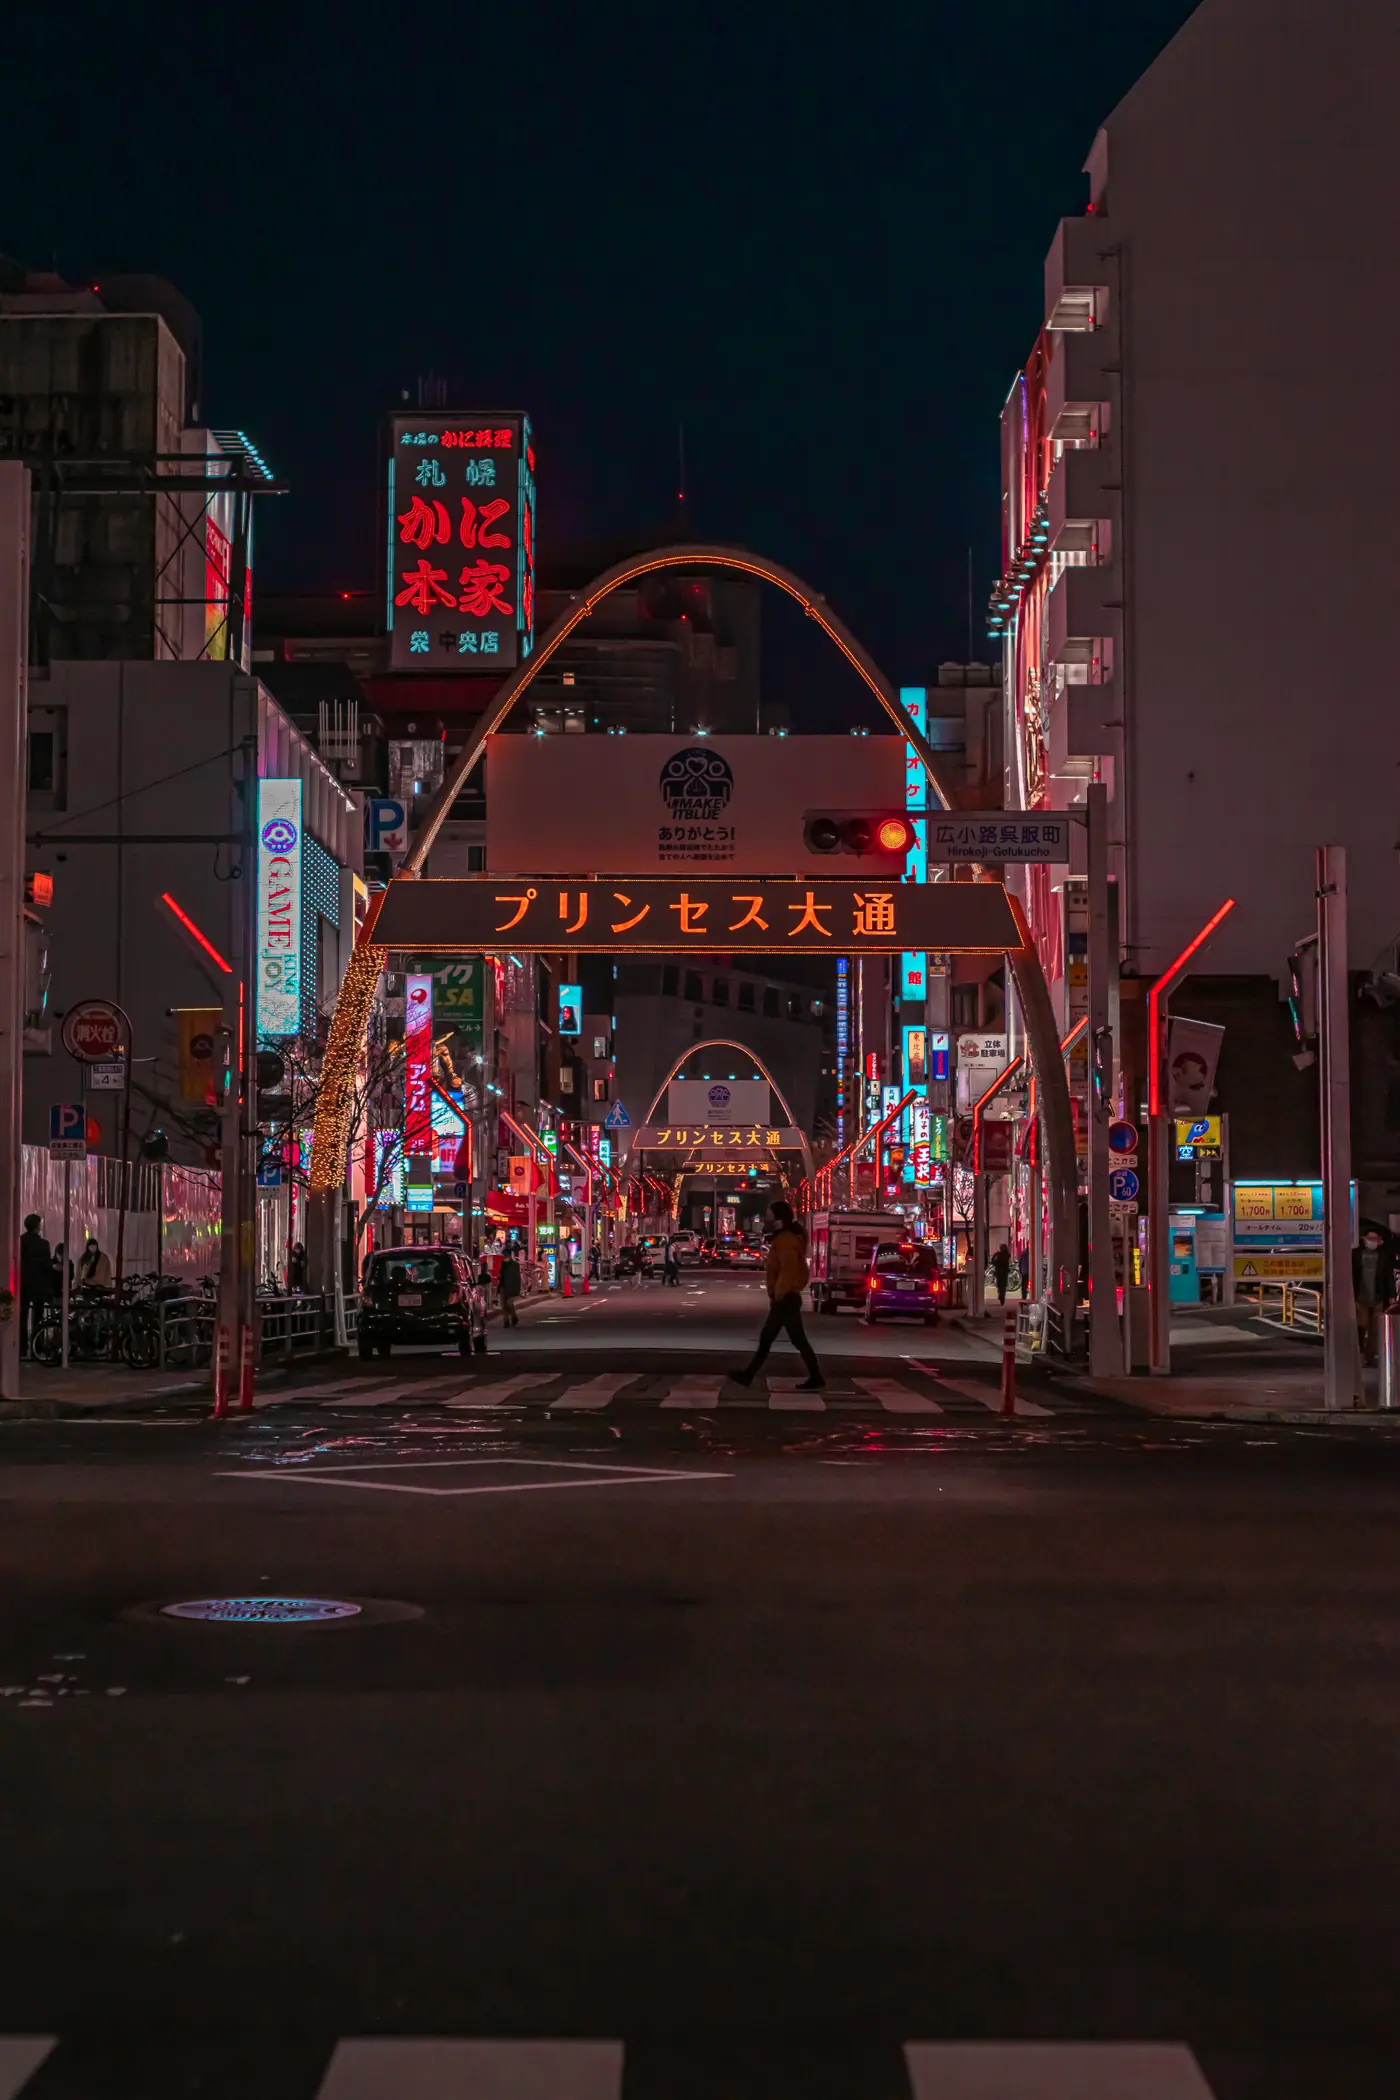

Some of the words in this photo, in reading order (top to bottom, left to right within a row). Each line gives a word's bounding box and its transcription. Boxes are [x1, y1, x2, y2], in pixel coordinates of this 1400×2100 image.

[414, 458, 497, 487] 札幌
[397, 495, 511, 550] かに
[394, 559, 514, 617] 本家
[372, 801, 404, 849] P
[936, 825, 1061, 844] 広小路呉服町
[947, 846, 1050, 859] Hirokoji-Gofukucho
[268, 856, 292, 949] GAME
[495, 887, 897, 936] プリンセス大通
[75, 1023, 117, 1044] 消火栓
[984, 1040, 1001, 1049] 立体
[410, 1064, 427, 1112] アコム
[59, 1106, 79, 1136] P
[656, 1130, 781, 1145] プリンセス大通
[1113, 1176, 1126, 1196] P
